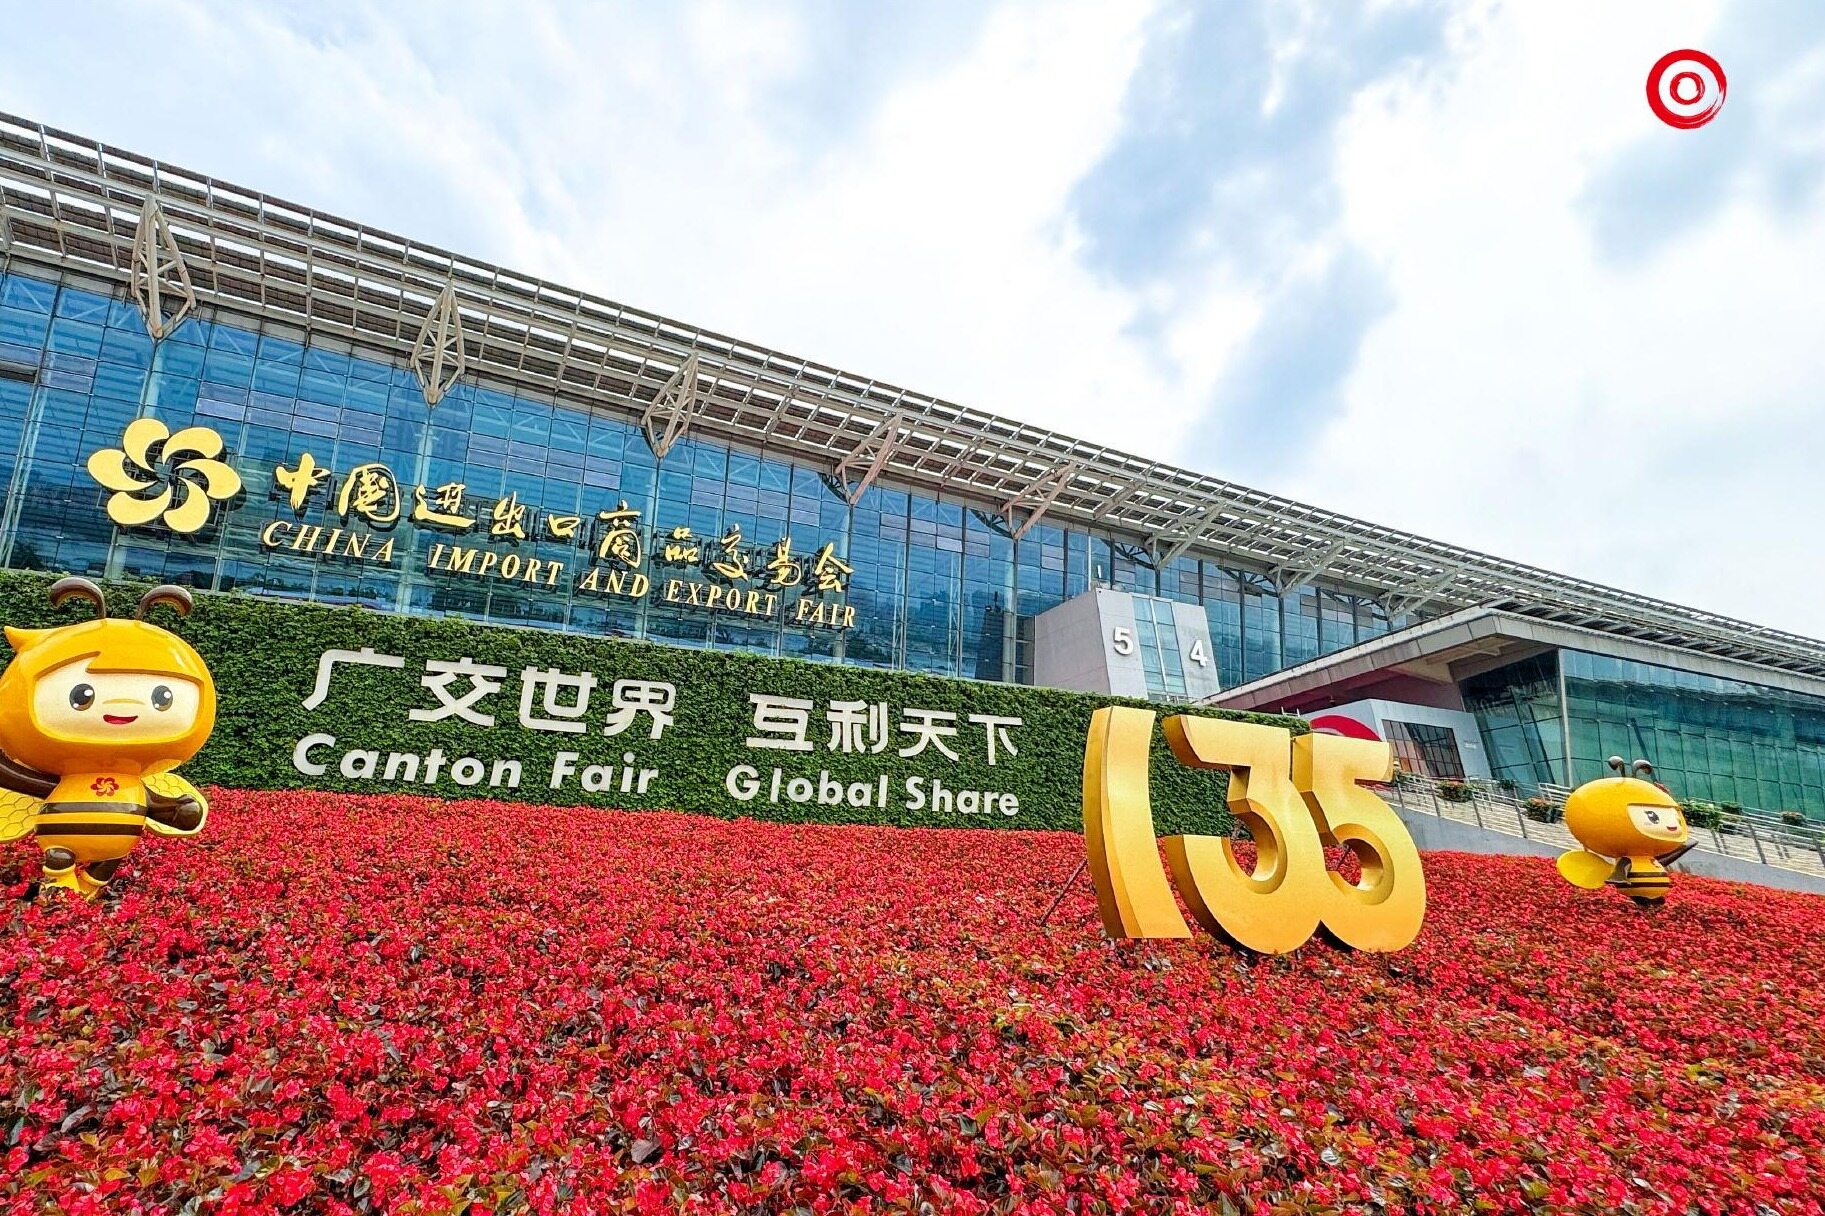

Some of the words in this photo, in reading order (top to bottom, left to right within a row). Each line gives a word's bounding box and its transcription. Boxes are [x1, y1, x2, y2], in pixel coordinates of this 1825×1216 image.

[262, 520, 395, 562] CHINA
[427, 543, 564, 585] IMPORT
[579, 567, 649, 598] AND
[665, 579, 778, 616] EXPORT
[795, 598, 856, 628] FAIR
[1113, 626, 1134, 655] 5
[1190, 639, 1208, 667] 4
[301, 647, 676, 740] 广交世界
[746, 693, 1023, 766] 互利天下
[292, 733, 522, 790] Canton
[549, 751, 659, 794] Fair
[726, 764, 889, 808] Global
[905, 776, 1019, 816] Share
[1083, 706, 1427, 954] 135
